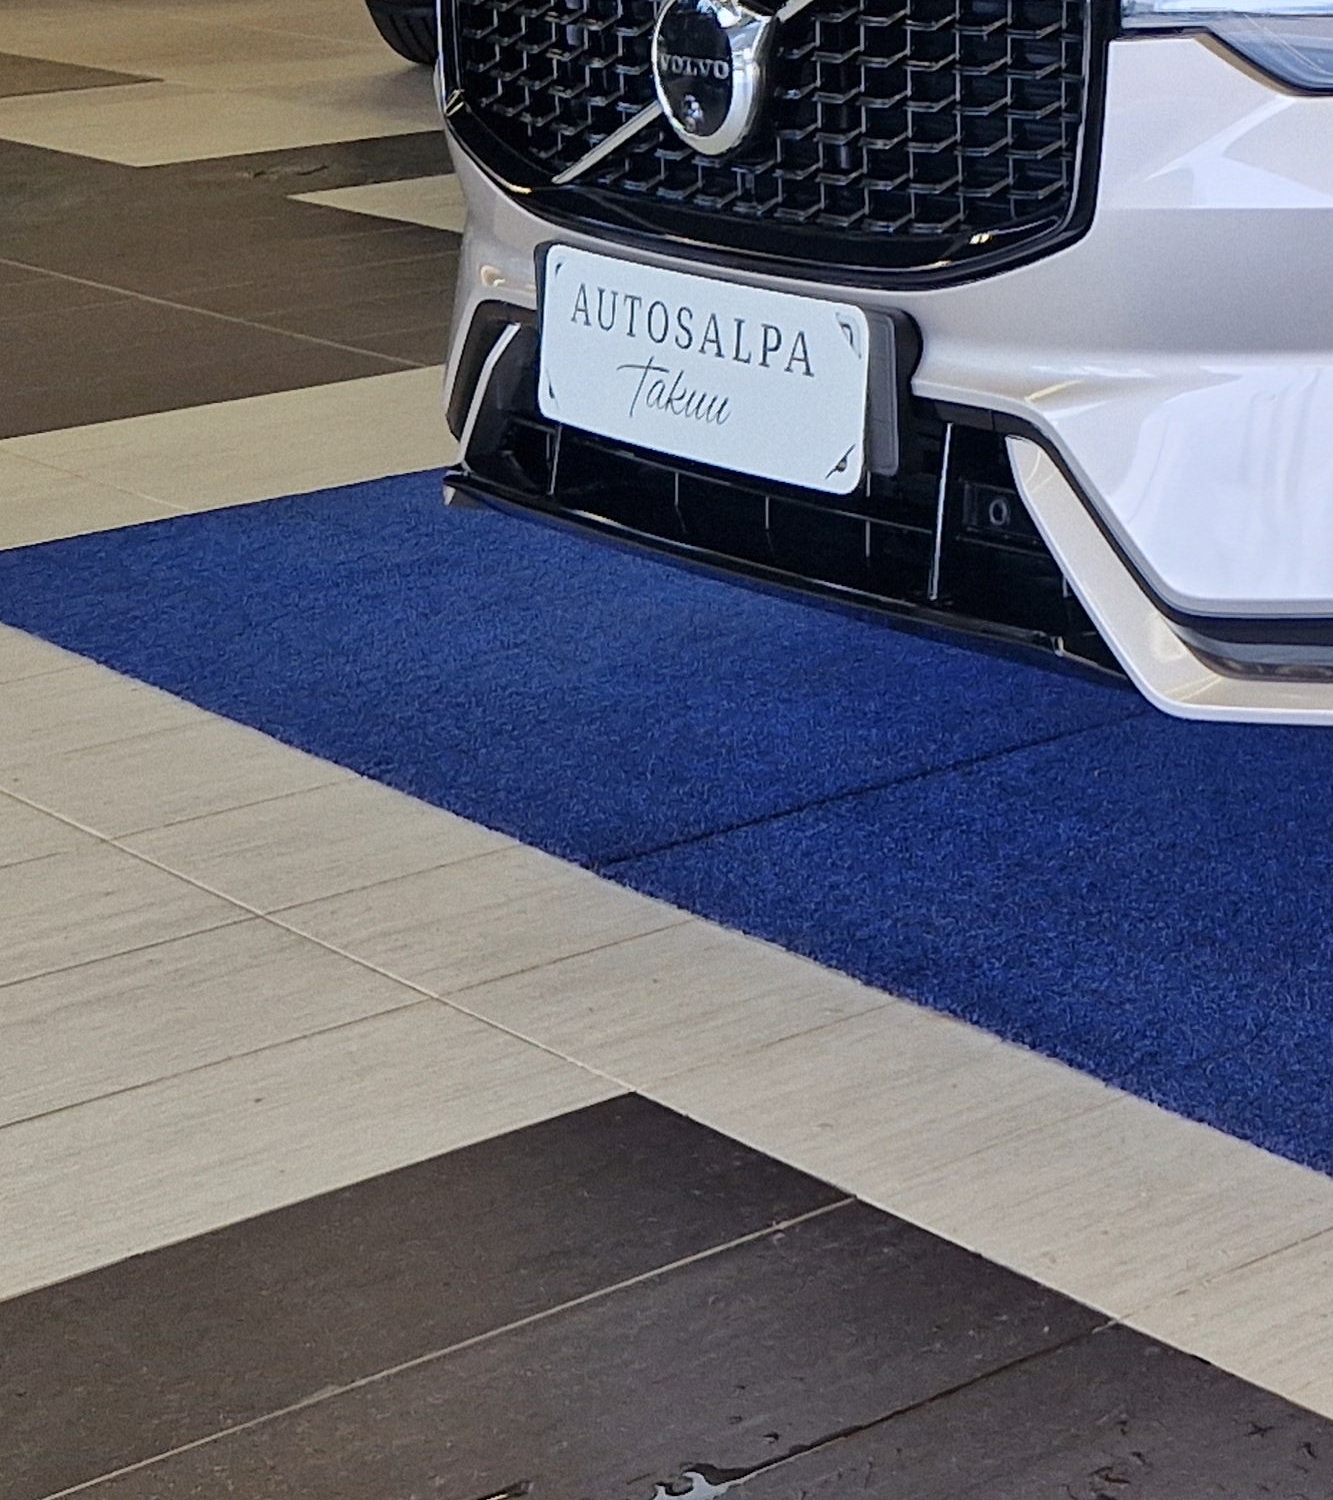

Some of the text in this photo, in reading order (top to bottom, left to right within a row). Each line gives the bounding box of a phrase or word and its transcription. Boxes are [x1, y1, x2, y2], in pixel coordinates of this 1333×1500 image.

[660, 54, 730, 80] VOLVO
[571, 283, 815, 378] AUTOSALPA
[616, 356, 732, 426] Takuu
